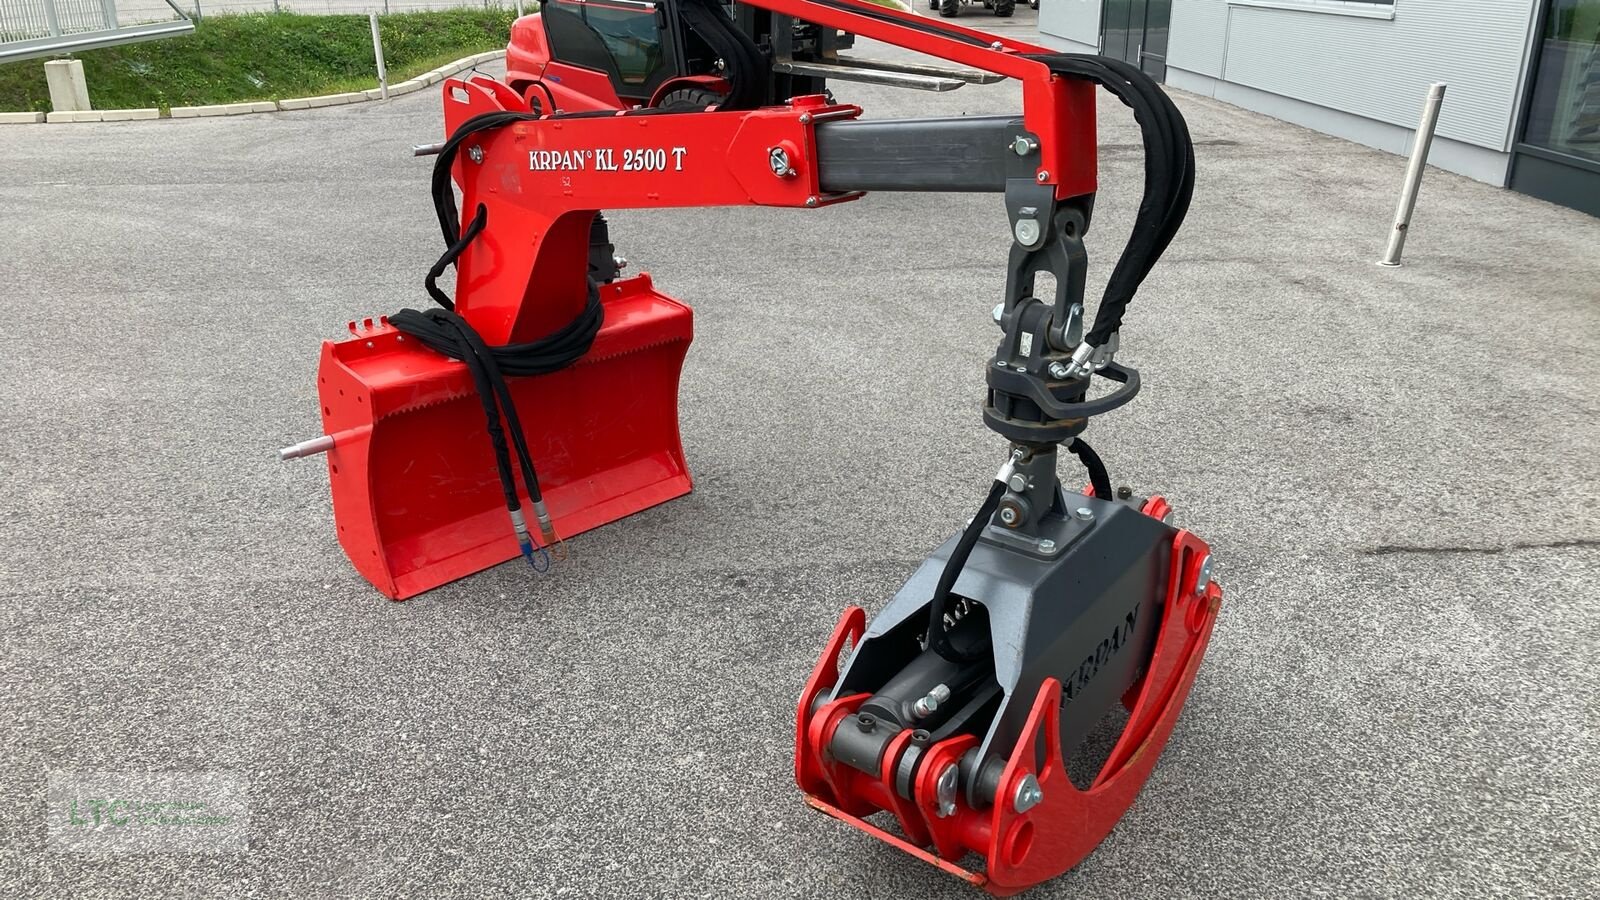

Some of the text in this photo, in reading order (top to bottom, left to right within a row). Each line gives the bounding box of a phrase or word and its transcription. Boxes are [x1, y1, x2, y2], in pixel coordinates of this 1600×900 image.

[594, 148, 619, 172] KL
[623, 148, 667, 172] 2500
[671, 146, 688, 171] T
